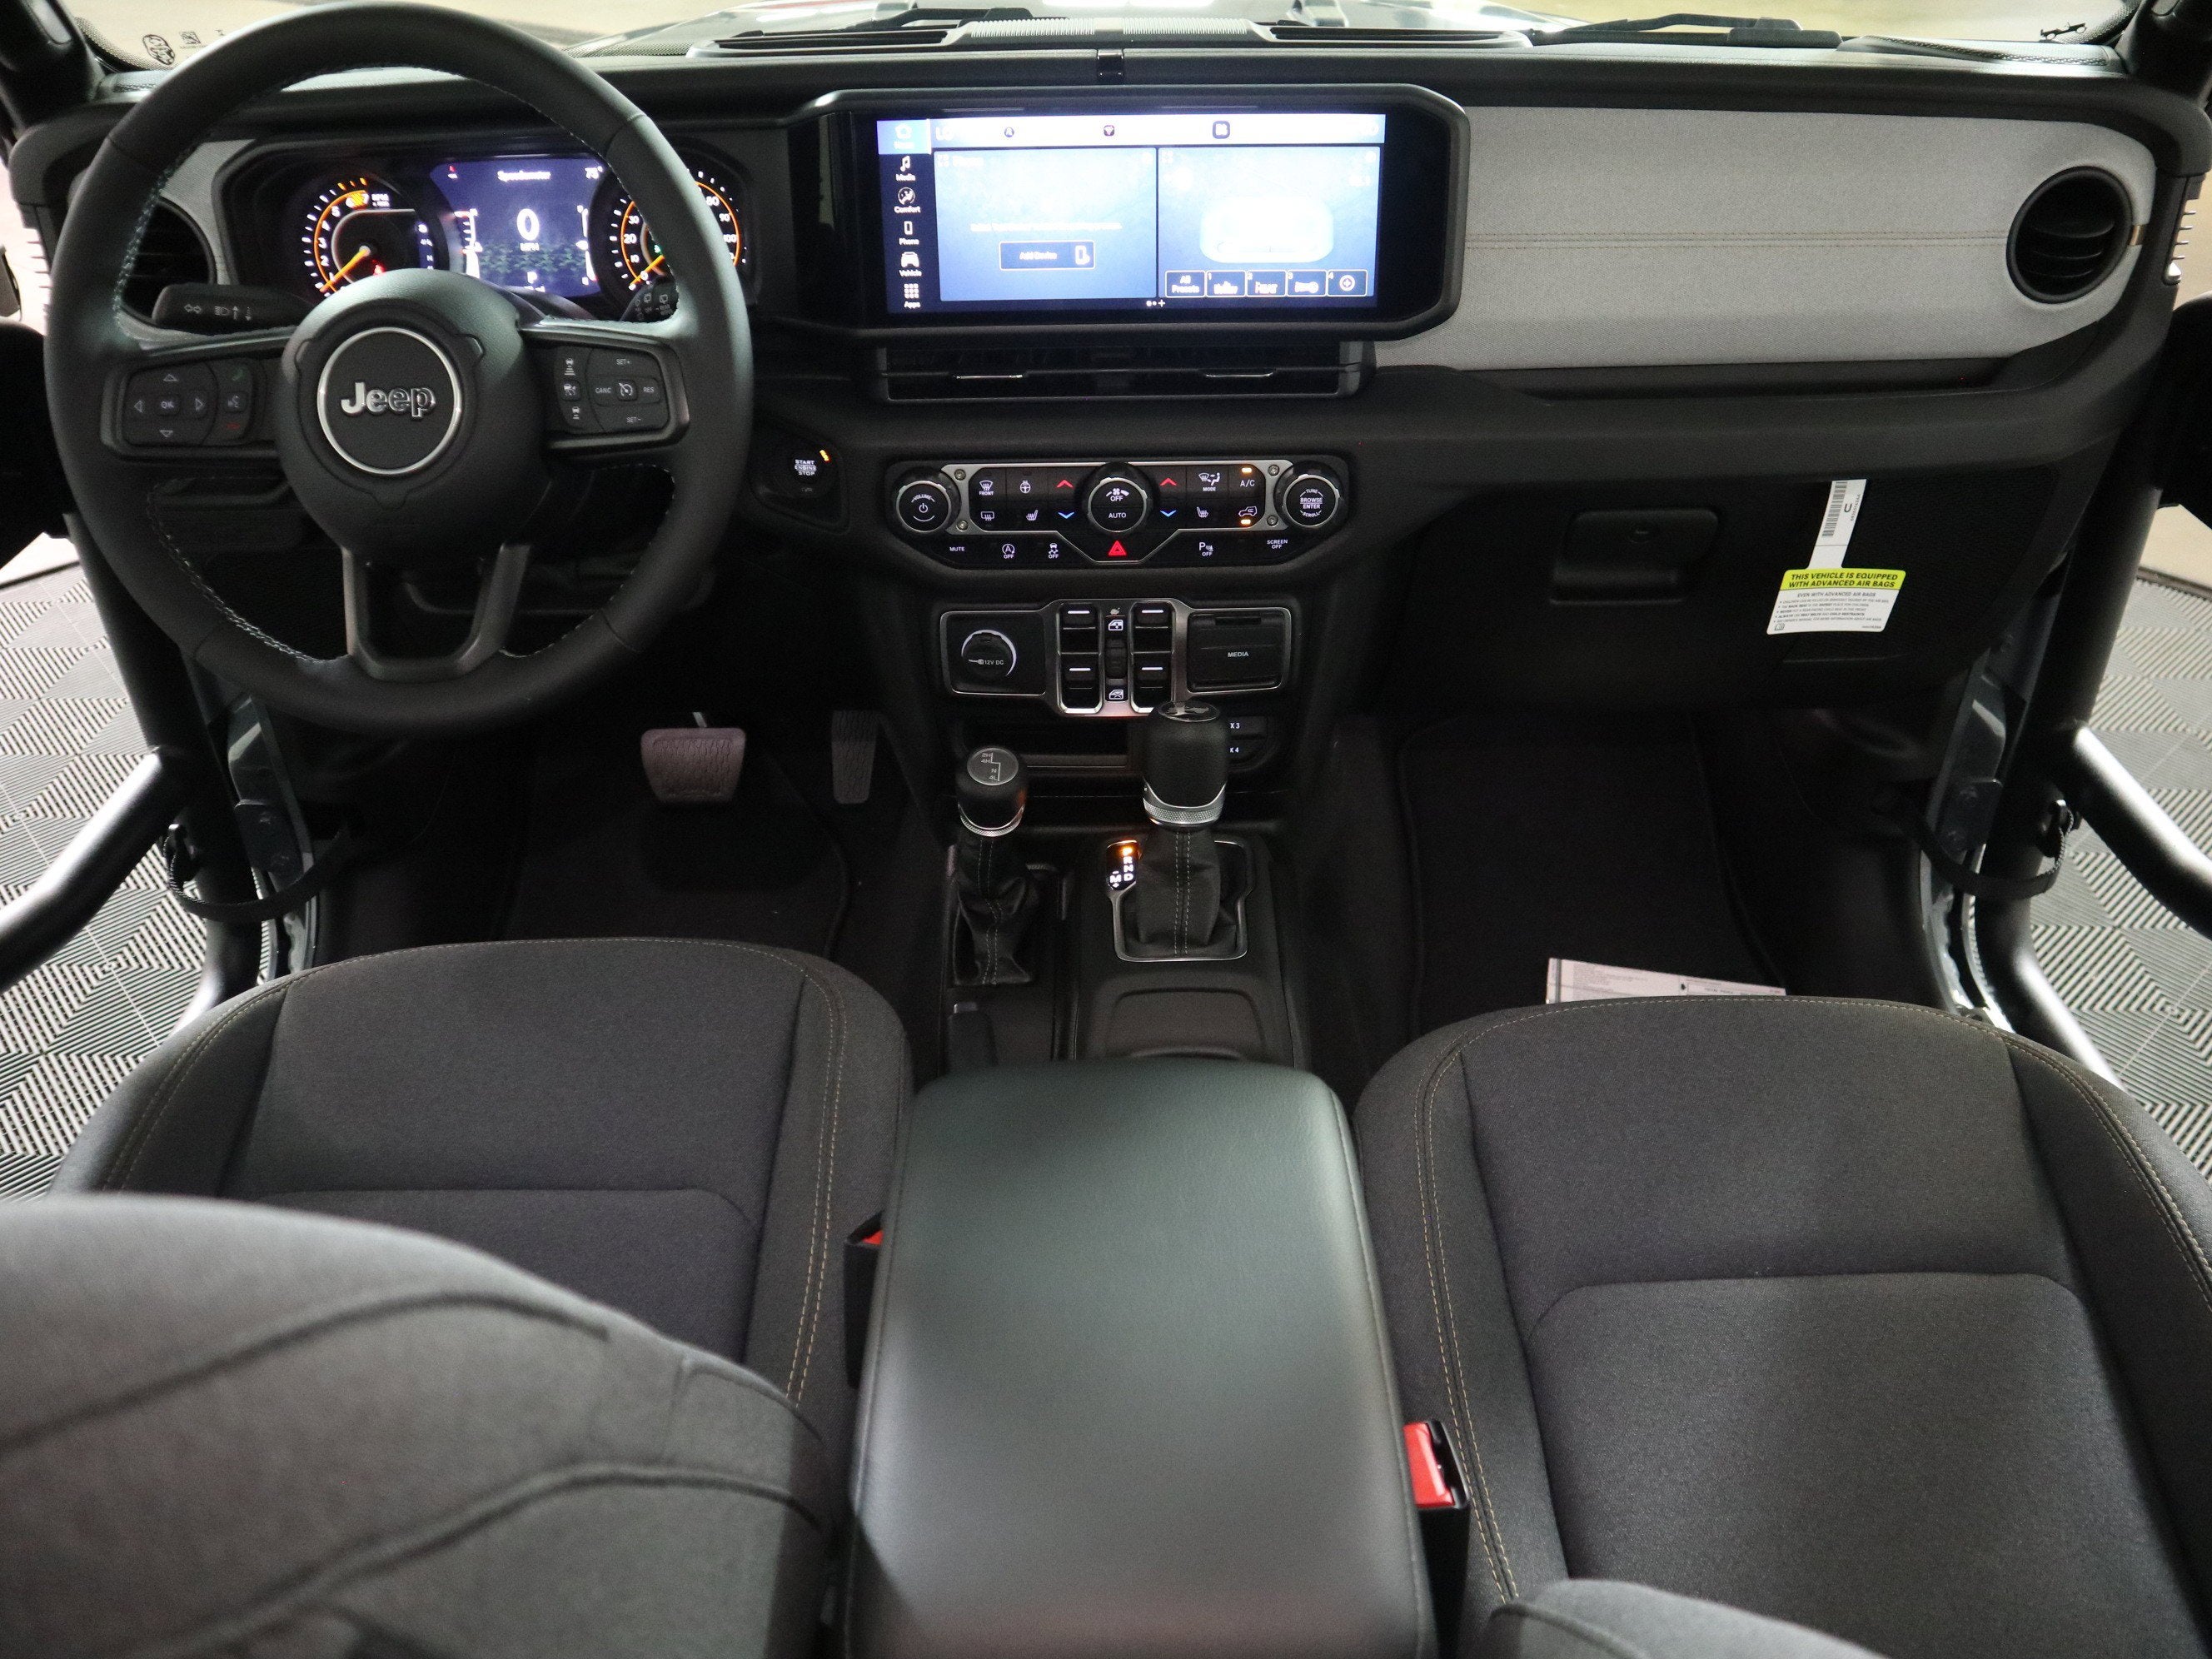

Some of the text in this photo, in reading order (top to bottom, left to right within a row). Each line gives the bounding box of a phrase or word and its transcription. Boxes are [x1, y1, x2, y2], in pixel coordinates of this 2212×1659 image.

[516, 208, 540, 241] 0
[623, 234, 637, 244] 20
[341, 381, 436, 417] Jeep
[161, 401, 175, 409] OK
[1239, 479, 1256, 487] A/C
[1856, 572, 1898, 580] EQUIPPED
[1227, 650, 1249, 659] MEDIA
[1123, 856, 1133, 864] R
[1123, 864, 1134, 873] N
[1109, 874, 1123, 884] M
[1123, 873, 1134, 882] D
